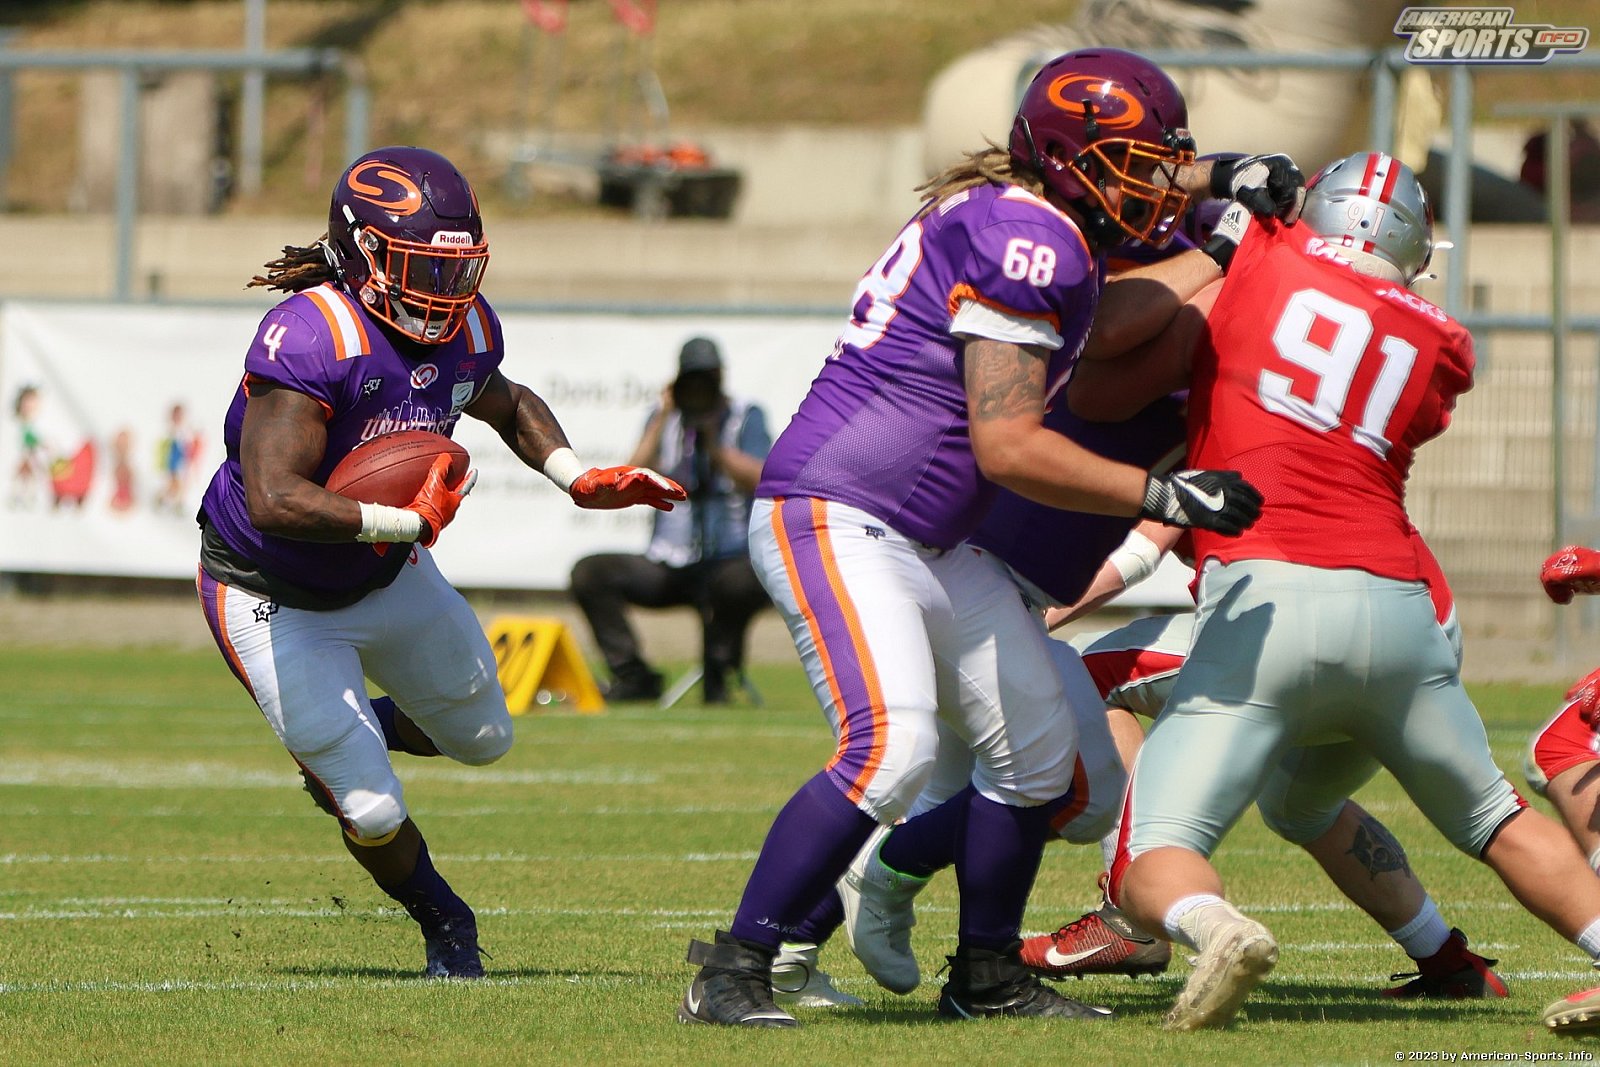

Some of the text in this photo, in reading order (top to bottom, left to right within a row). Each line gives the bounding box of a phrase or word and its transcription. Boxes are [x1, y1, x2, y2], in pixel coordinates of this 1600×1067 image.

[439, 234, 471, 245] Riddell
[1347, 201, 1387, 238] 91
[1002, 237, 1057, 289] 68
[262, 322, 288, 362] 4
[1258, 288, 1419, 462] 91
